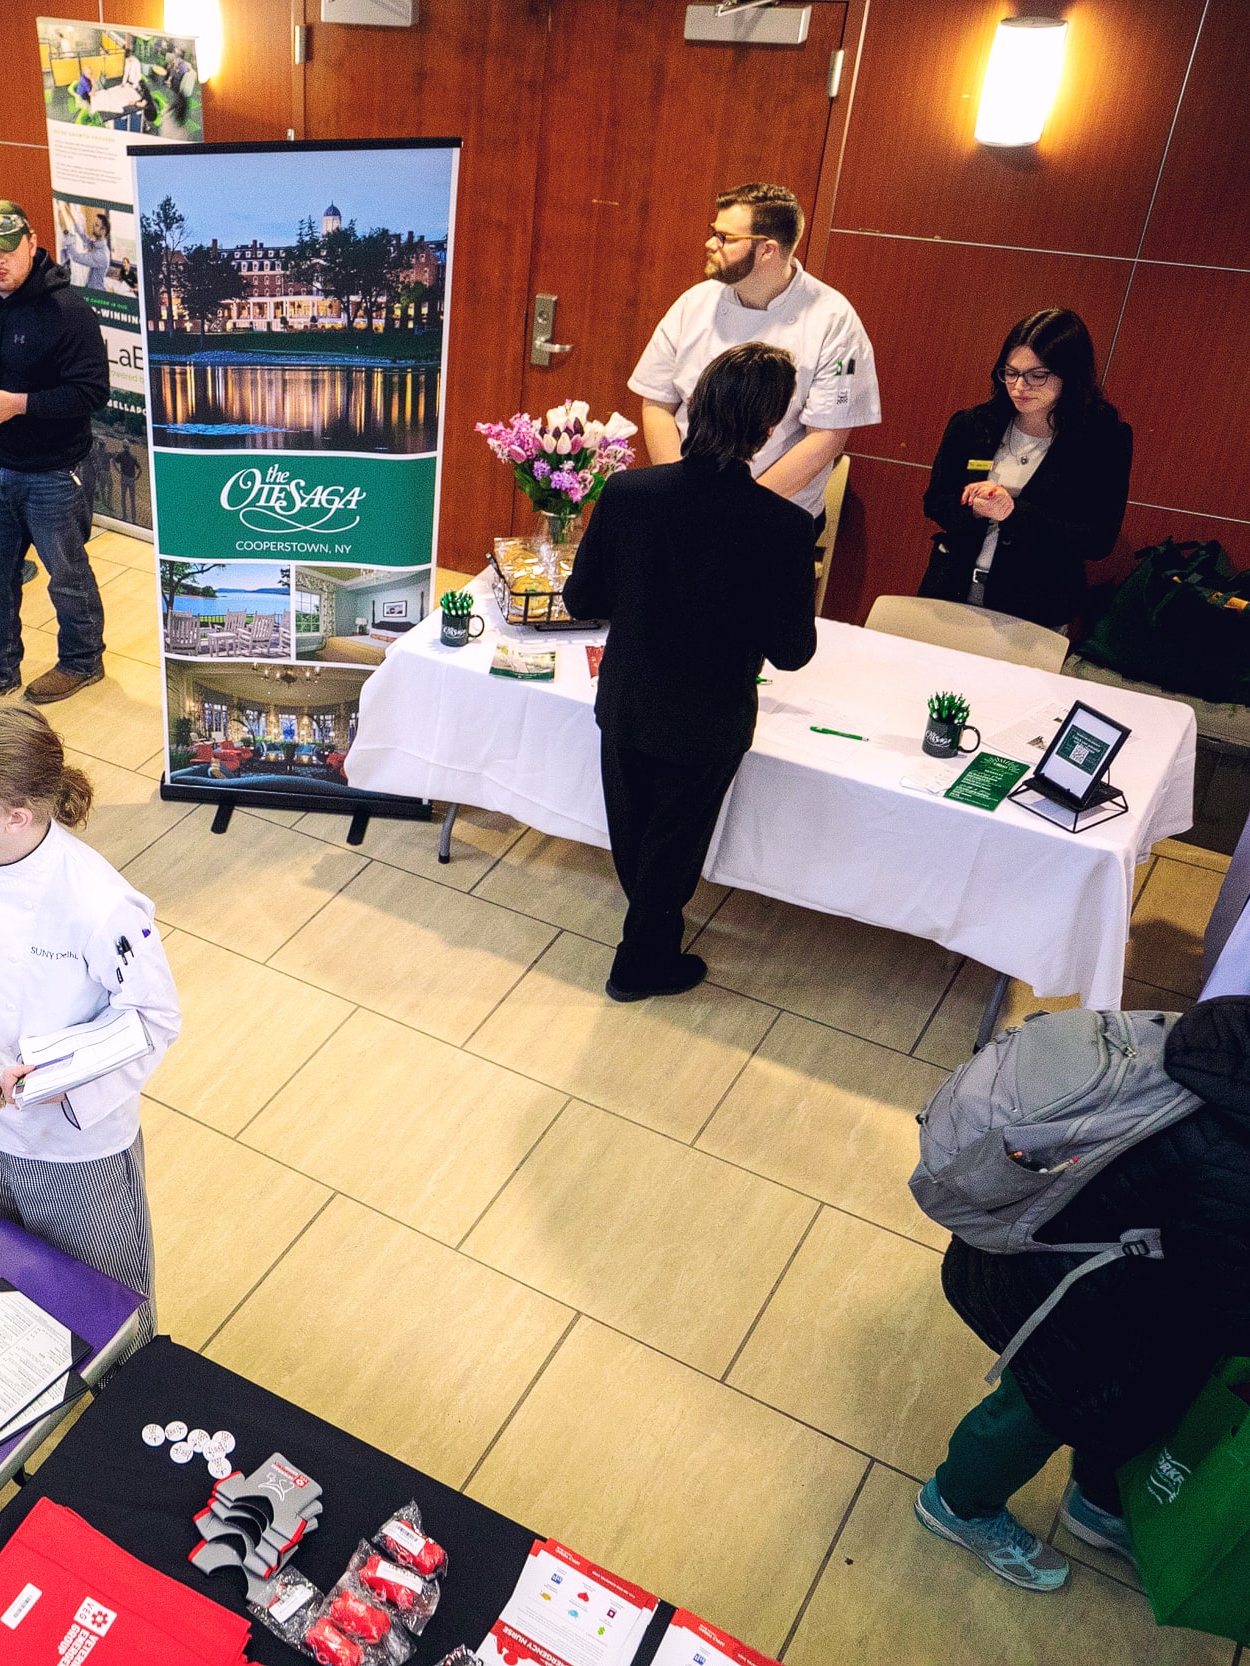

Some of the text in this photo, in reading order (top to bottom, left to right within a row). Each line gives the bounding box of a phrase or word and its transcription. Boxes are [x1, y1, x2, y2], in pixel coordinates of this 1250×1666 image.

[266, 464, 290, 484] the
[235, 540, 352, 555] COOPERSTOWN, NY
[31, 946, 55, 960] SUNY
[79, 1602, 95, 1621] VEG
[56, 1628, 91, 1666] EMERGE
[57, 1623, 81, 1656] GROUP
[502, 1624, 576, 1666] ERGENCY NURSE
